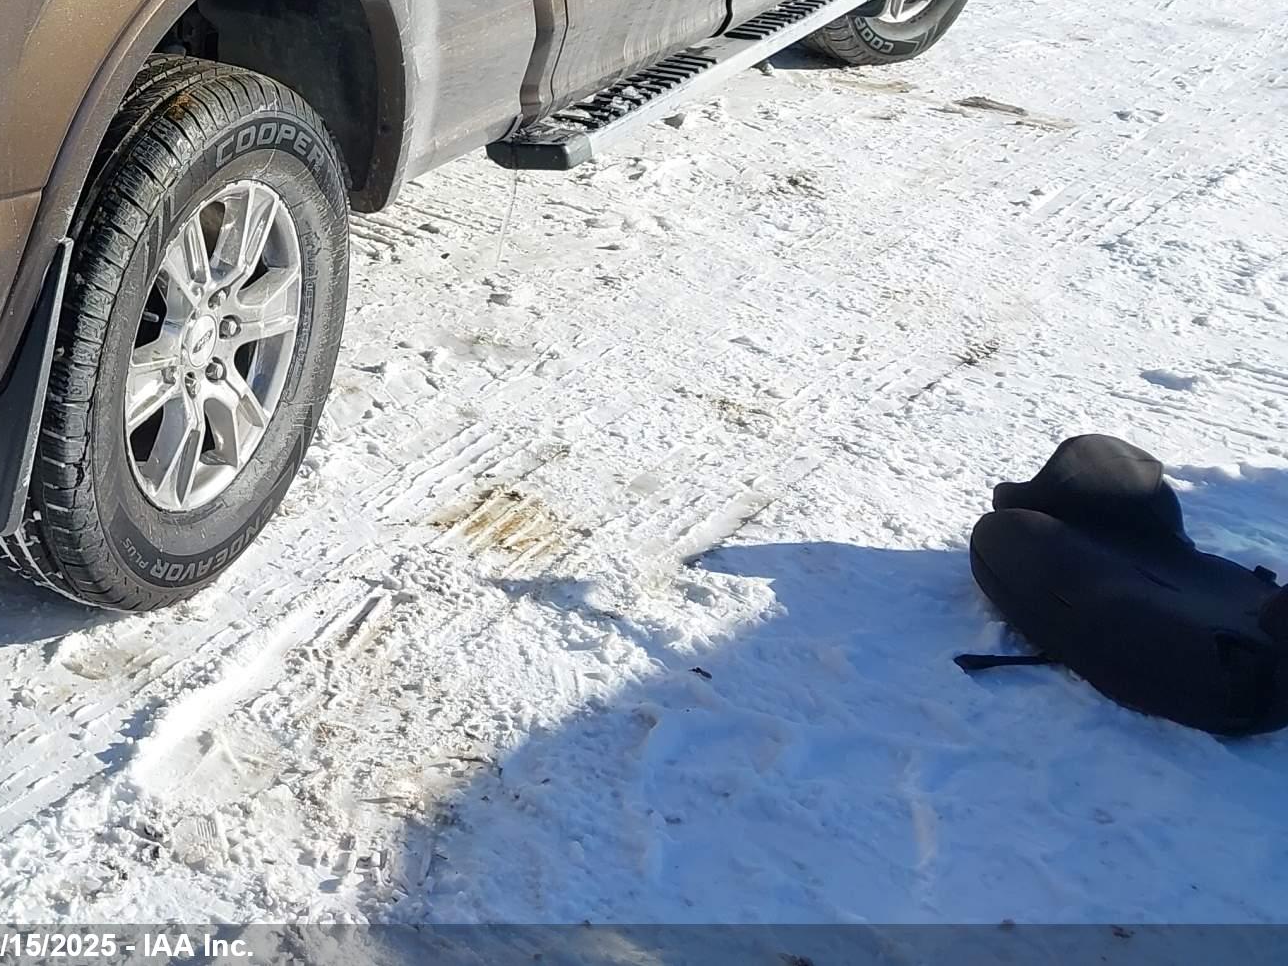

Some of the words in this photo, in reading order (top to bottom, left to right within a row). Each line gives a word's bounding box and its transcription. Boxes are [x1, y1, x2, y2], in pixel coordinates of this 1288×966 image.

[215, 122, 325, 172] COOPER
[121, 537, 149, 569] PLUS
[150, 497, 274, 582] ENDEAVOR
